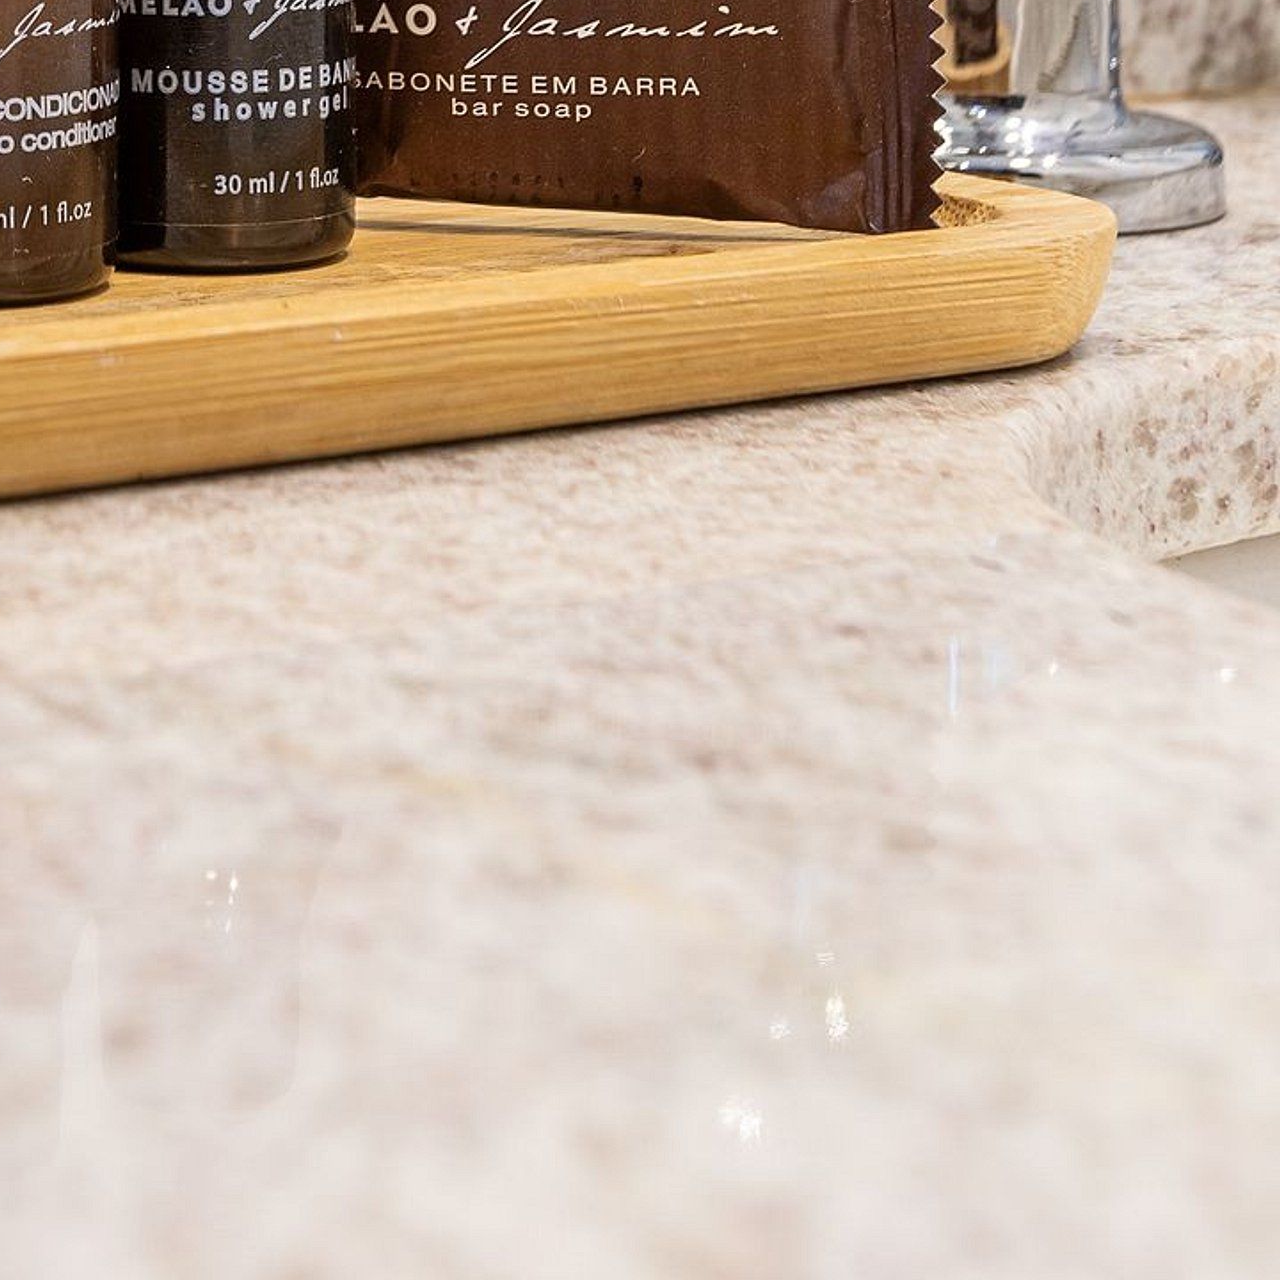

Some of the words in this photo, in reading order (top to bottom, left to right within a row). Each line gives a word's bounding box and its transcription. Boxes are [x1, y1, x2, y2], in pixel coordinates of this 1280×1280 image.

[130, 67, 270, 94] MOUSSE
[278, 65, 313, 93] DE
[531, 75, 576, 95] EM
[589, 76, 701, 96] BARRA
[190, 96, 312, 122] shower
[319, 85, 348, 119] gel
[451, 97, 503, 116] bar
[514, 101, 593, 122] soap
[21, 116, 117, 153] conditioner
[213, 174, 242, 195] 30
[248, 170, 275, 194] ml
[295, 170, 303, 191] 1
[40, 204, 48, 226] 1
[57, 200, 92, 225] fl.oz
